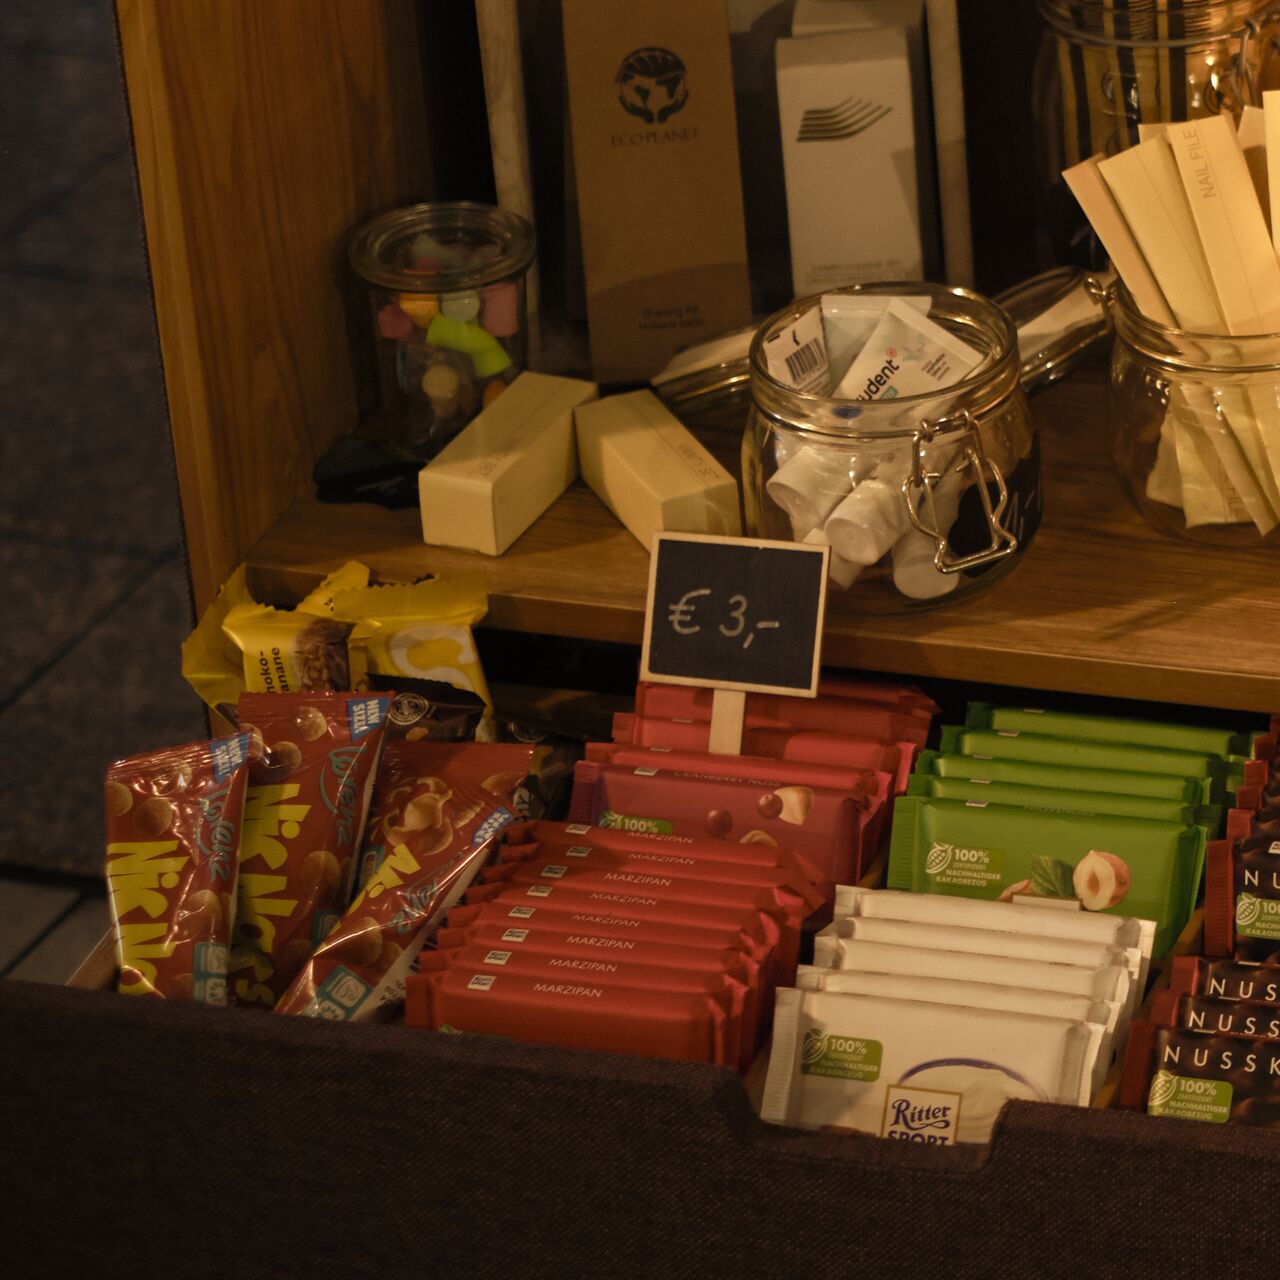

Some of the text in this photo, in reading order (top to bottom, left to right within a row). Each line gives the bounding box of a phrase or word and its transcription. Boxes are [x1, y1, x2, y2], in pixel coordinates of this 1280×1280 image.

[1183, 129, 1217, 198] NAIL FILE
[856, 358, 900, 403] udent
[667, 588, 712, 635] €
[366, 699, 381, 724] NEW
[621, 816, 657, 832] 100%
[627, 851, 696, 866] MARZIPAN
[954, 847, 990, 865] 100%
[603, 872, 672, 887] MARZIPAN
[945, 868, 1001, 880] NACHHALTIGER
[590, 892, 658, 908] MARZIPAN
[572, 913, 641, 929] MARZIPAN
[566, 935, 635, 951] MARZIPAN
[549, 958, 618, 973] MARZIPAN
[532, 983, 603, 998] MARZIPAN
[831, 1038, 868, 1055] 100%
[1179, 1079, 1218, 1096] 100%
[890, 1098, 952, 1131] Ritter
[1169, 1100, 1228, 1114] NACHHALTIGER
